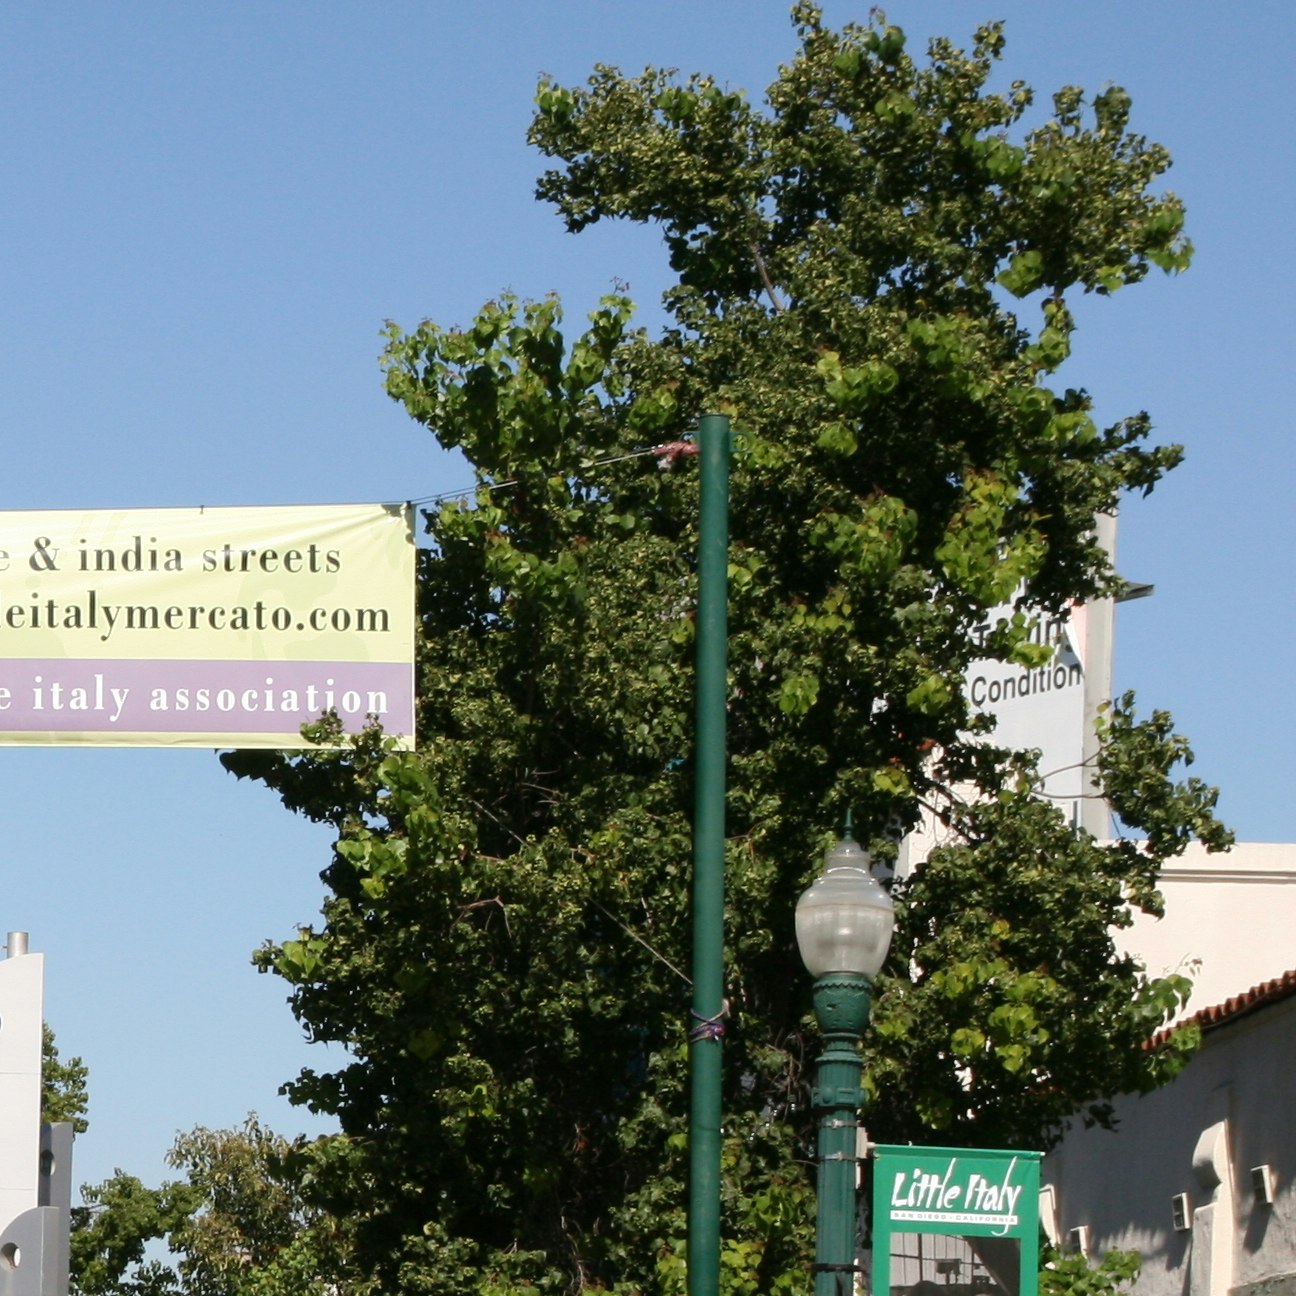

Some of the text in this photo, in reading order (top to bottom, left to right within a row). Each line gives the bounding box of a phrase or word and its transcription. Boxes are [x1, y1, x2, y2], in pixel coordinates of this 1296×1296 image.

[28, 536, 61, 571] &
[77, 536, 185, 571] india
[201, 543, 342, 573] streets
[31, 673, 131, 722] italy
[148, 677, 390, 715] association
[971, 663, 1082, 707] Condition
[890, 1155, 1023, 1236] Little Italy
